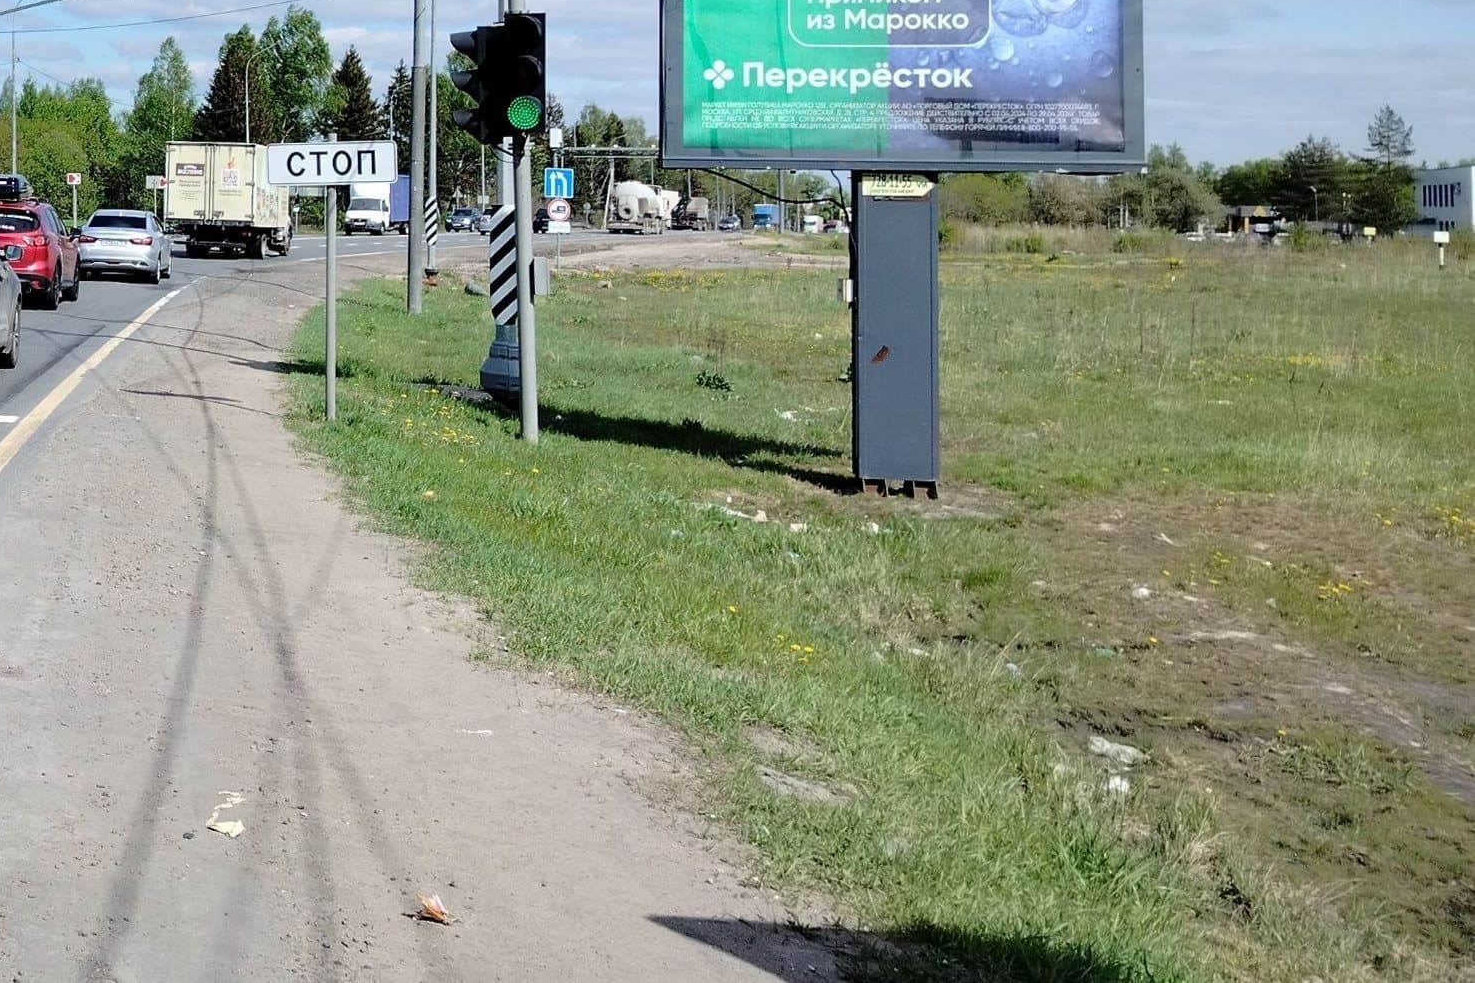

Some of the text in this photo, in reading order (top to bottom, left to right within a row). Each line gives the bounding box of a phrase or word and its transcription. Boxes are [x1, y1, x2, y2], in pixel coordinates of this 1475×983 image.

[806, 8, 970, 35] из Марокко
[743, 62, 973, 94] Перекрёсток
[286, 150, 377, 177] СТОП
